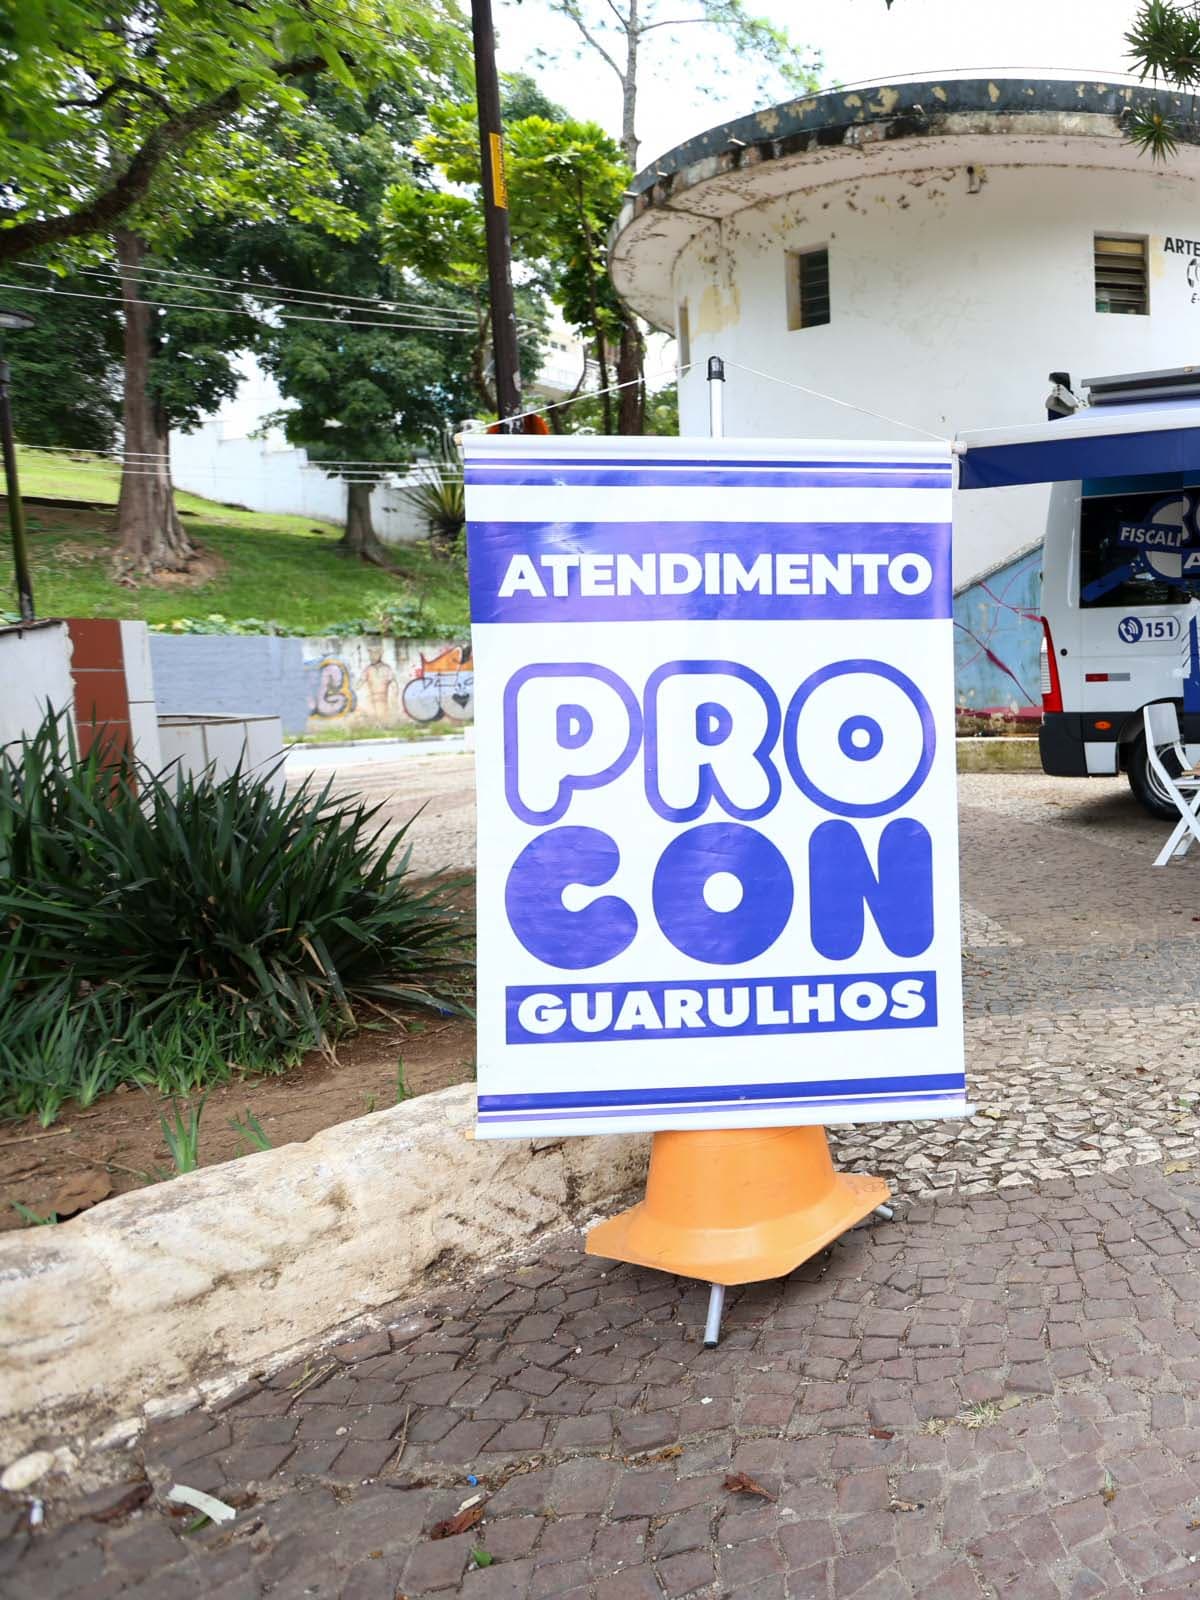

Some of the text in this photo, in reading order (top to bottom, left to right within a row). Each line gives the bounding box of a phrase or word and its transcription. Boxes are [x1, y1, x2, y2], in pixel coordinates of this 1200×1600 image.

[498, 552, 933, 598] ATENDIMENTO
[1145, 620, 1175, 638] 151
[503, 658, 936, 826] PRO
[505, 817, 935, 969] CON
[517, 978, 927, 1035] GUARULHOS
